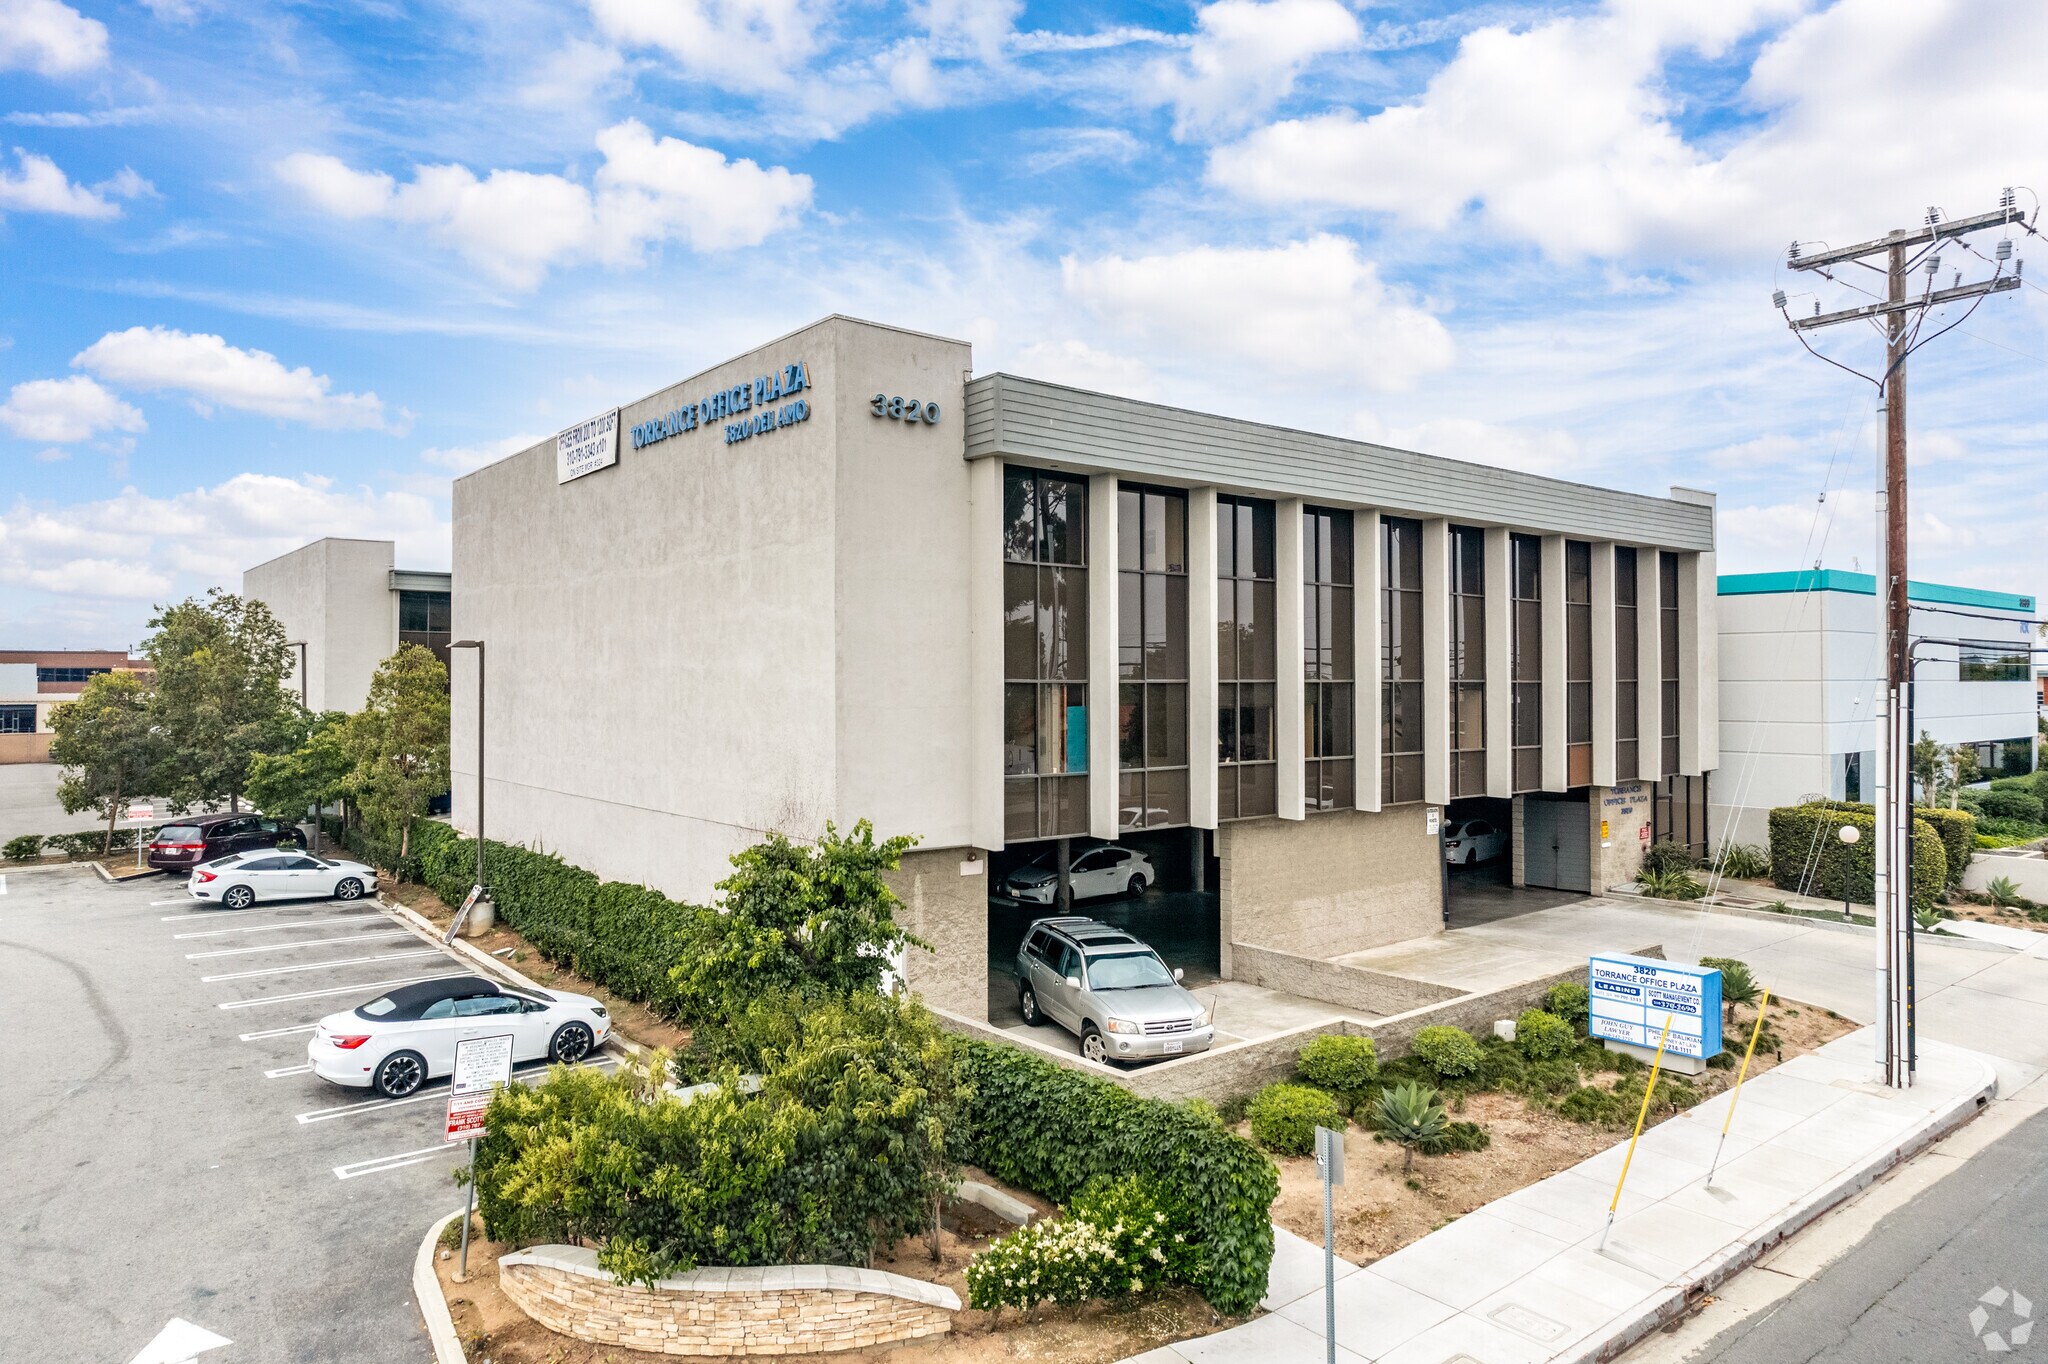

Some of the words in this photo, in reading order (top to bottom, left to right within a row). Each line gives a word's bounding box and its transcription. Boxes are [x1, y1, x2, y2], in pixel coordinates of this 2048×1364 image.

[630, 403, 698, 449] TORRANCE
[700, 383, 751, 424] OFFICE
[753, 361, 811, 406] PLAZA
[870, 393, 942, 425] 3820
[752, 410, 776, 436] DEL
[777, 399, 811, 428] AMO
[1634, 966, 1656, 977] 3820
[1595, 968, 1637, 983] TORRANCE
[1639, 976, 1668, 989] OFFICE
[1670, 981, 1698, 994] PLAZA
[1597, 983, 1637, 995] LEASING
[1648, 989, 1662, 999] SCOTT
[1662, 992, 1693, 1004] MANAGEMENT
[1601, 1019, 1619, 1028] JOHN
[1619, 1023, 1633, 1031] GUY
[1604, 1026, 1631, 1037] LAWYER
[1672, 1033, 1703, 1045] BALIKIAN
[449, 1119, 466, 1127] FRANK
